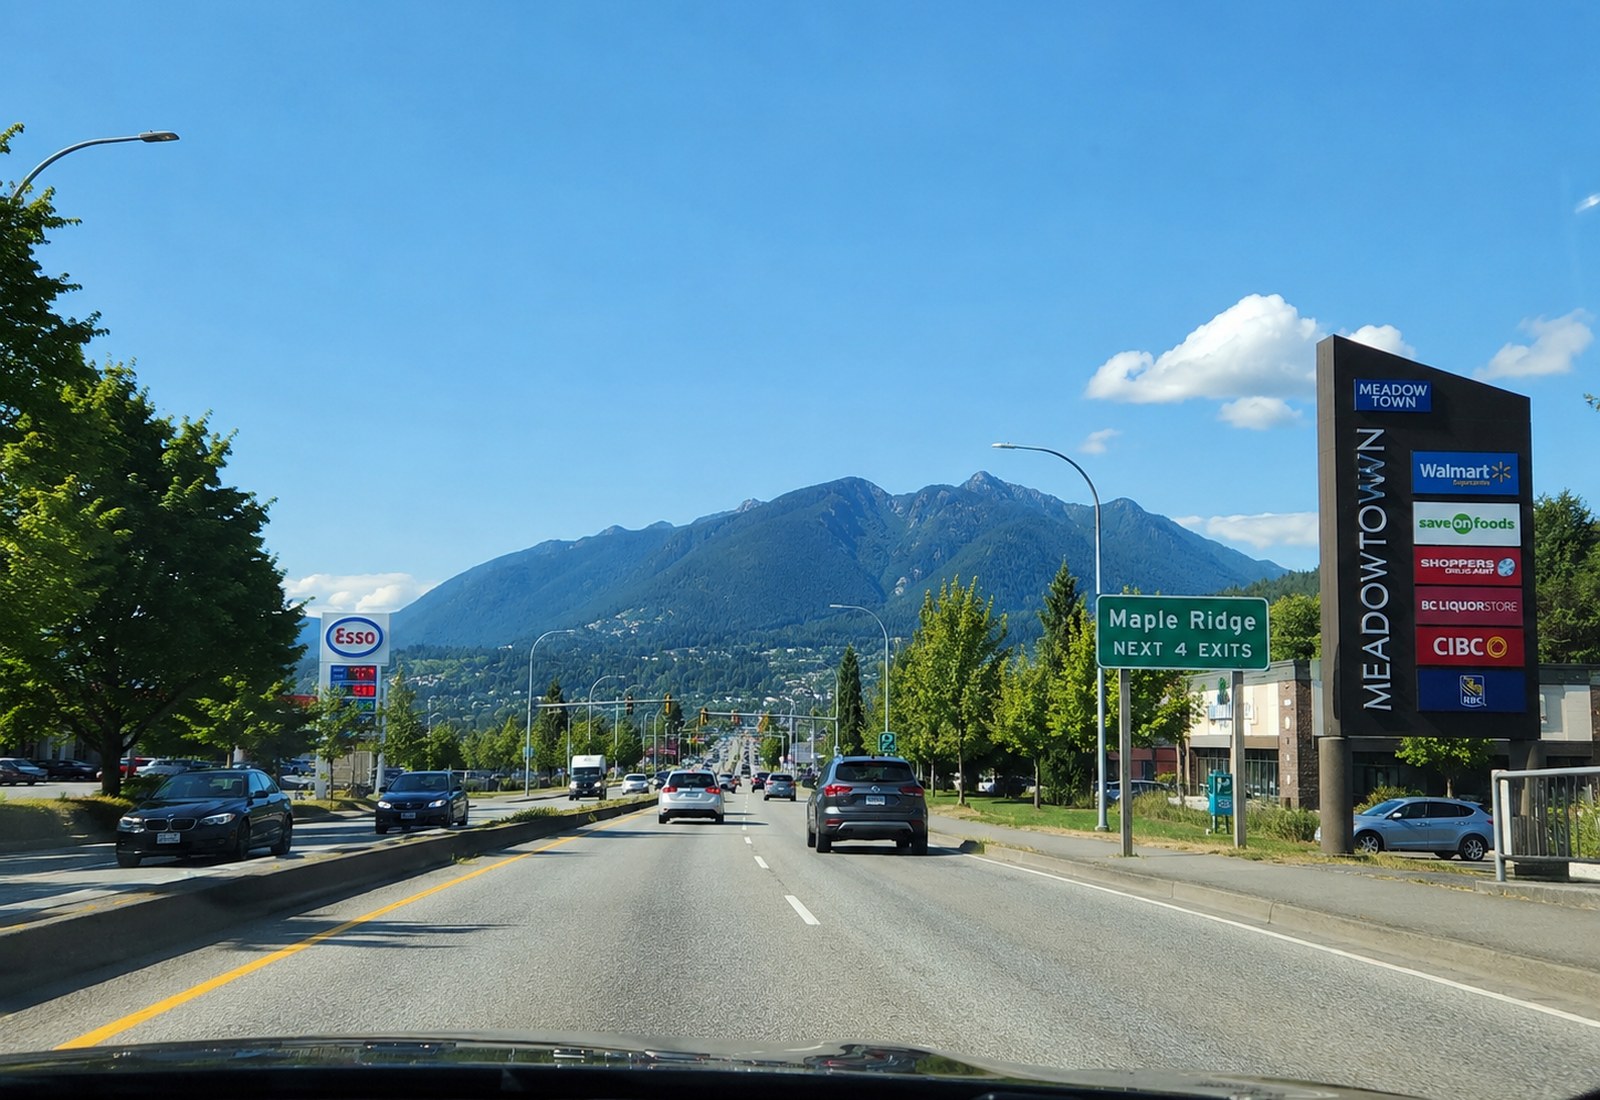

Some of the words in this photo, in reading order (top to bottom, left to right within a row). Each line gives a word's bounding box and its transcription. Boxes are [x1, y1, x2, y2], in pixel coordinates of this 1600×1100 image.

[1359, 383, 1428, 397] MEADOW
[1371, 395, 1416, 408] TOWN
[1419, 463, 1490, 479] Walmart
[1420, 559, 1495, 568] SHOPPERS
[1421, 600, 1438, 610] BC
[1109, 608, 1179, 633] Maple
[1190, 610, 1256, 636] Ridge
[335, 627, 376, 645] Esso
[1113, 640, 1163, 656] NEXT
[1174, 642, 1188, 657] 4
[1198, 642, 1252, 658] EXITS
[1433, 636, 1485, 656] CIBC
[1463, 696, 1483, 704] RBC
